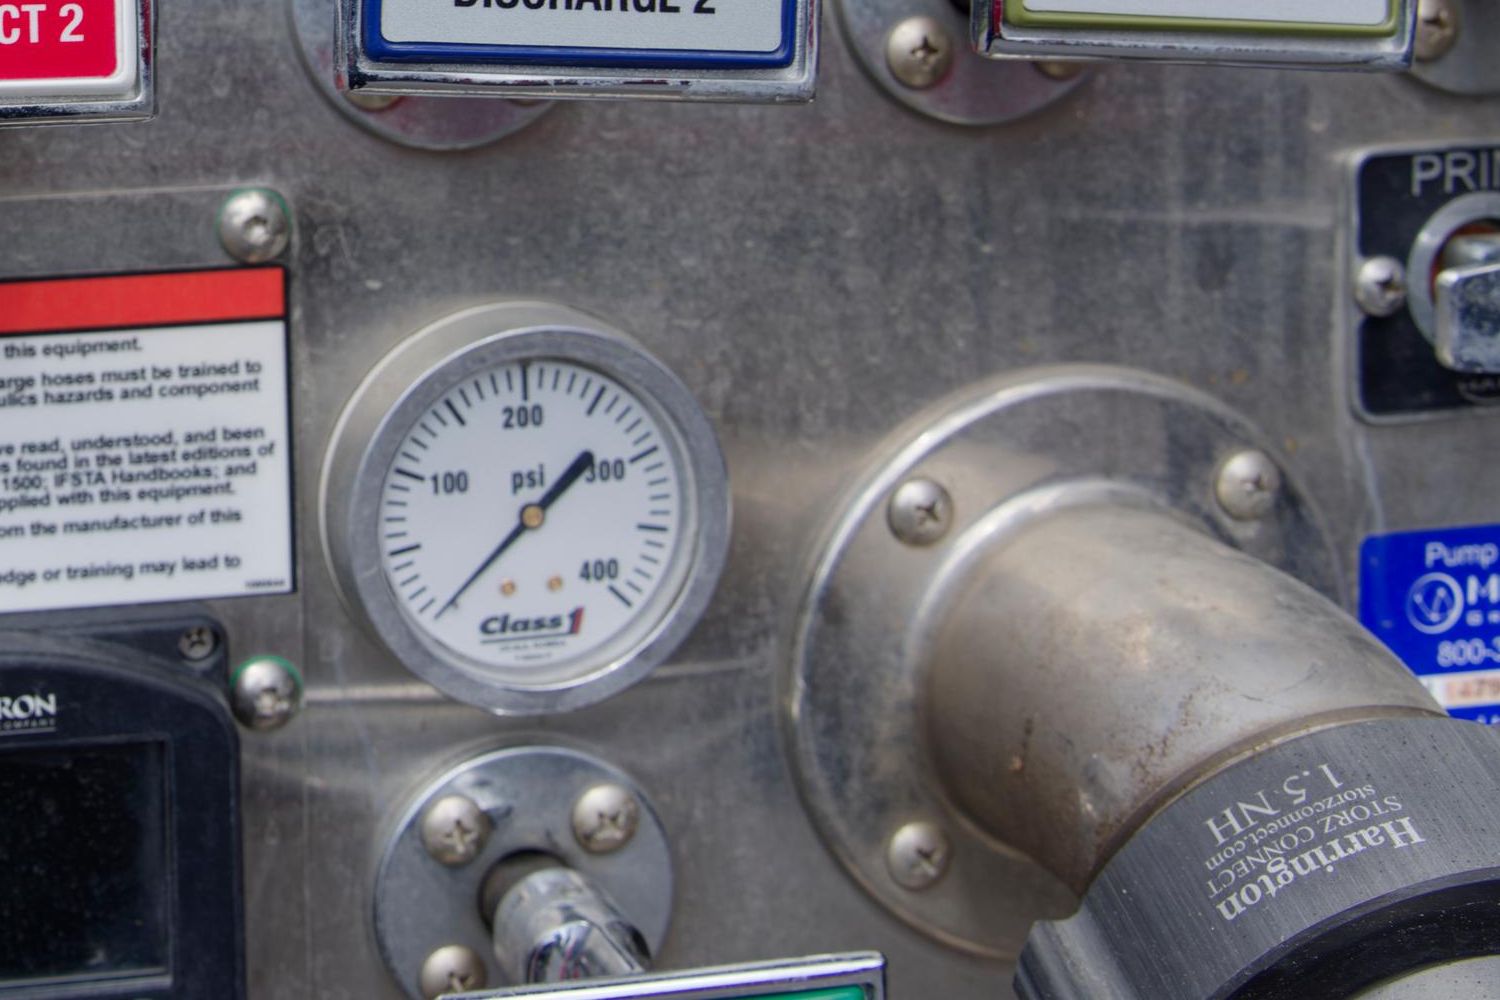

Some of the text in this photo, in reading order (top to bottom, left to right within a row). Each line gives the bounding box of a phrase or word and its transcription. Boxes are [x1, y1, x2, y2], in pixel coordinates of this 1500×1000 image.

[59, 3, 85, 43] 2
[2, 342, 37, 358] this
[41, 336, 145, 360] equipment.
[40, 369, 95, 386] hoses
[100, 366, 146, 383] must
[151, 364, 172, 379] be
[177, 360, 240, 378] trained
[244, 359, 261, 374] to
[42, 386, 114, 404] hazards
[119, 383, 153, 399] and
[158, 377, 259, 401] component
[502, 405, 543, 429] 200
[109, 463, 219, 486] Handbooks;
[222, 460, 259, 476] and
[430, 471, 469, 495] 100
[512, 463, 545, 495] psi
[585, 458, 626, 484] 300
[29, 520, 57, 535] the
[62, 511, 181, 533] manufacturer
[187, 510, 205, 525] of
[209, 507, 241, 523] this
[41, 569, 61, 580] or
[65, 560, 135, 583] training
[138, 561, 177, 578] may
[180, 555, 220, 571] lead
[223, 553, 241, 568] to
[1424, 541, 1500, 569] Pump
[579, 558, 619, 582] 400
[479, 606, 584, 635] Class1
[1203, 763, 1344, 847] 1.5 NH
[1204, 784, 1376, 871] storzconnect.com
[1206, 795, 1403, 898] STORZ CONNECT
[1215, 816, 1425, 921] Harrington
